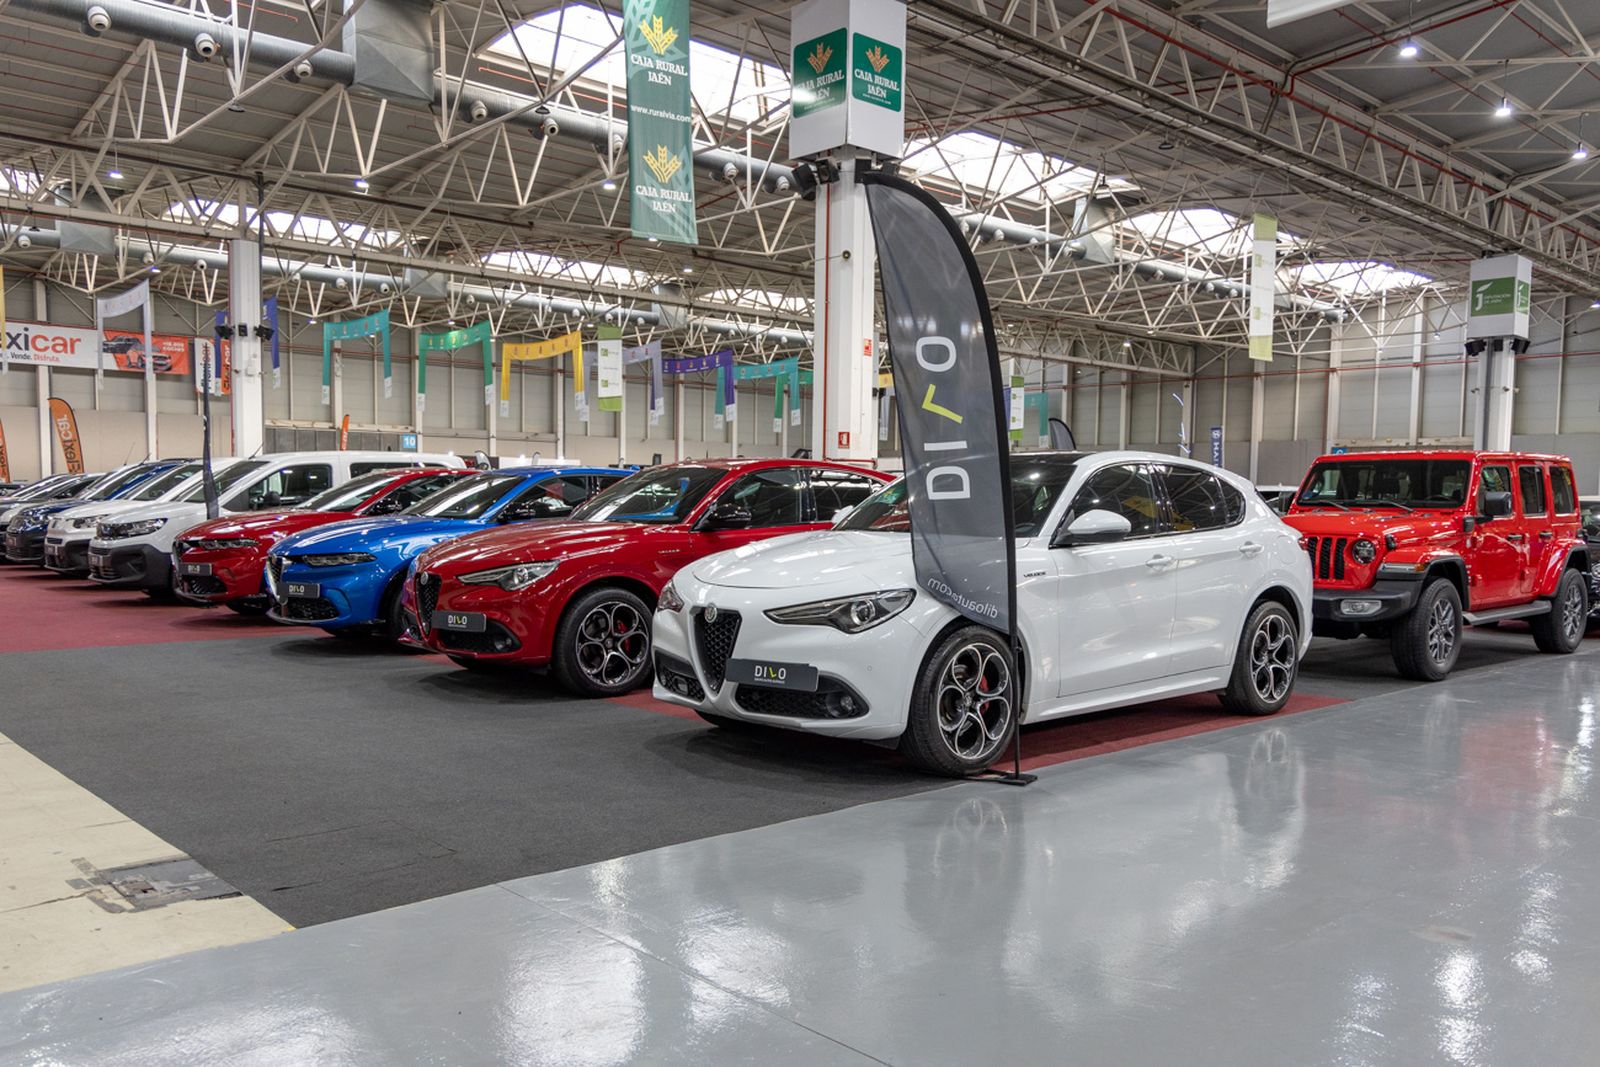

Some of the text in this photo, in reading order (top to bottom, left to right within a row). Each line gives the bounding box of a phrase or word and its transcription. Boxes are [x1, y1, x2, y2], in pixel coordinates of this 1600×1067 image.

[656, 60, 688, 76] RURAL
[874, 75, 900, 91] RURAL
[630, 105, 692, 122] www.ruralvia.com
[660, 189, 692, 202] RURAL
[0, 327, 82, 355] xicar
[404, 434, 416, 447] 10
[448, 614, 468, 625] DILO
[754, 665, 787, 680] DILO
